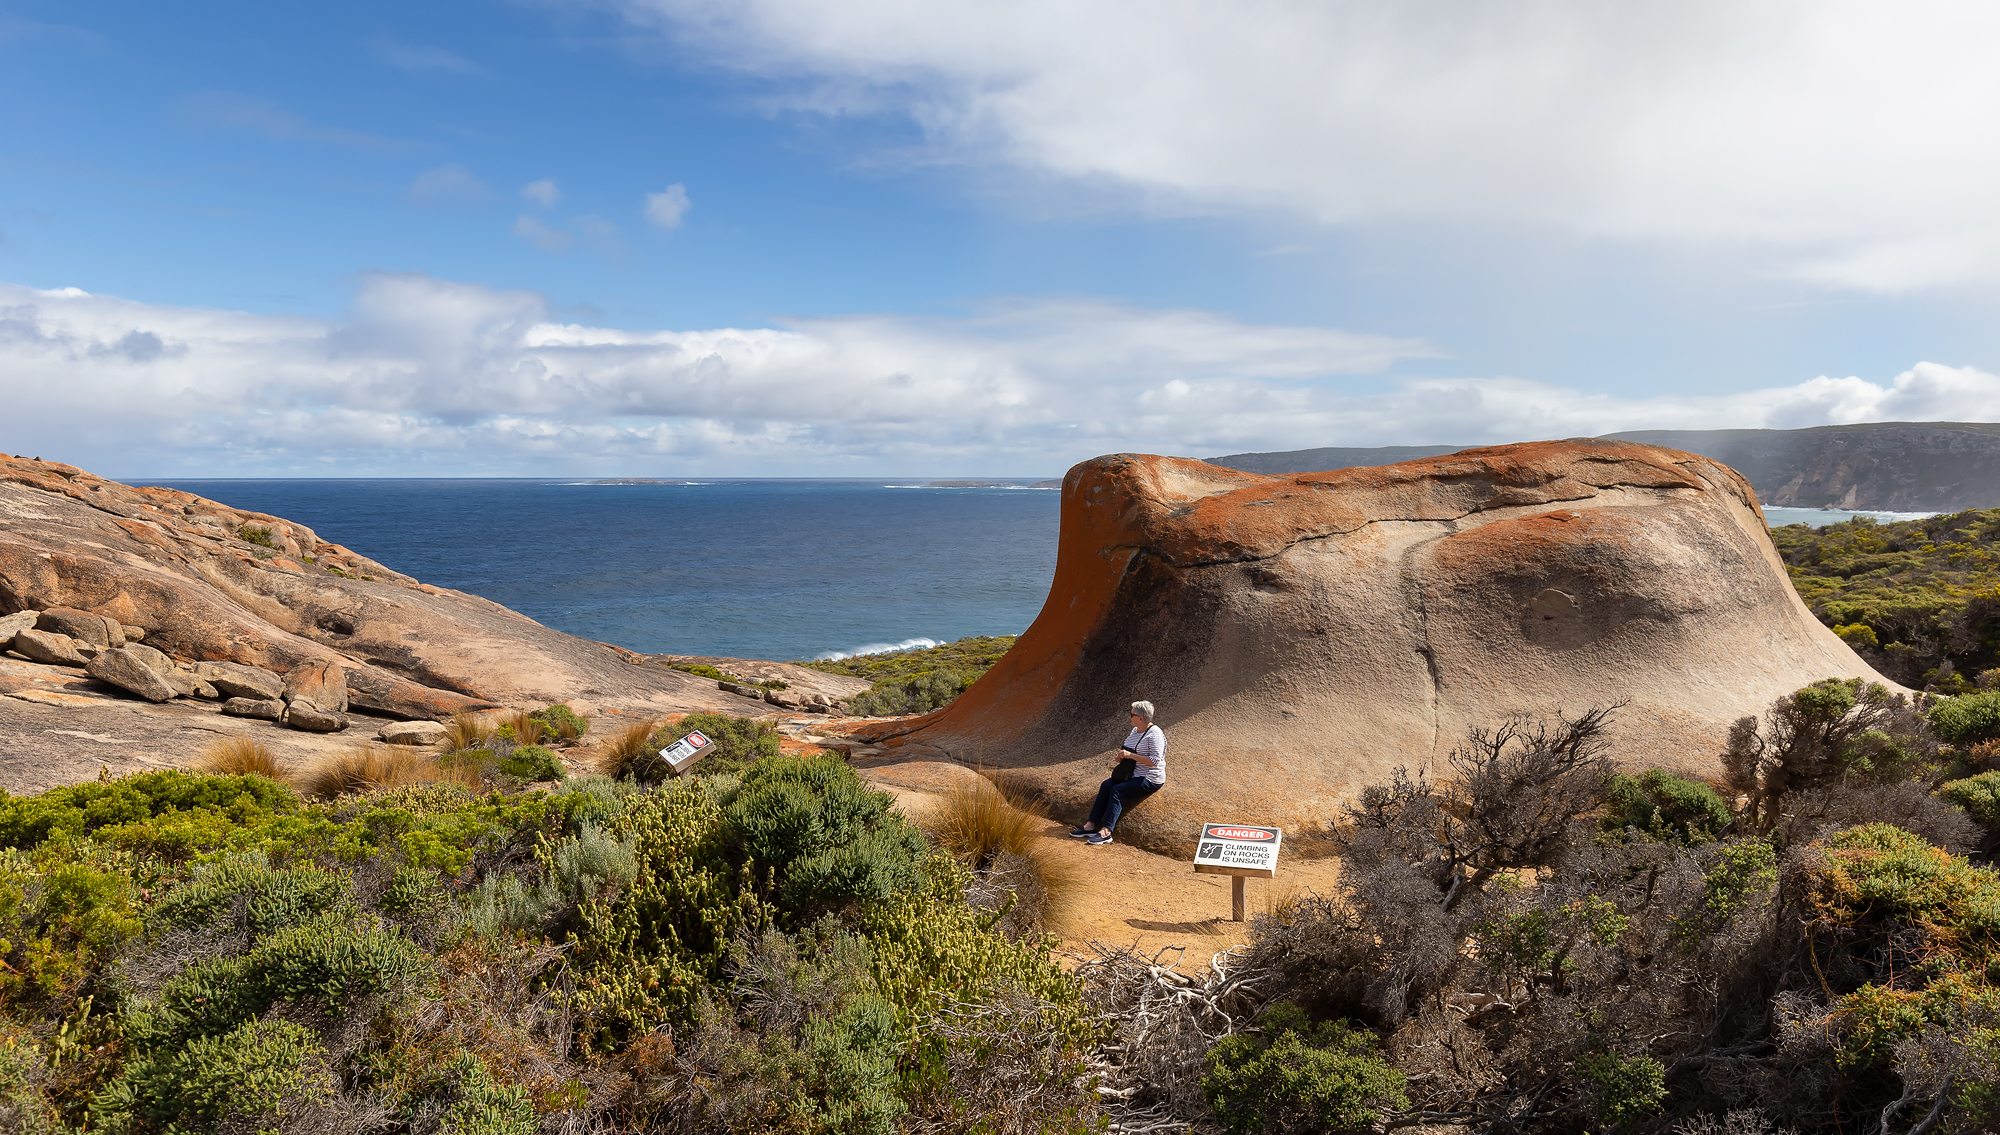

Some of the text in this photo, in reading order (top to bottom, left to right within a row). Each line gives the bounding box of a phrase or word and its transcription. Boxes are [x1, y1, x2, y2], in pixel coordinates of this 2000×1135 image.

[1217, 829, 1264, 839] DANGER
[1225, 843, 1268, 852] CLIMBING
[1238, 851, 1270, 859] ROCKS
[1232, 857, 1268, 865] UNSAFE
